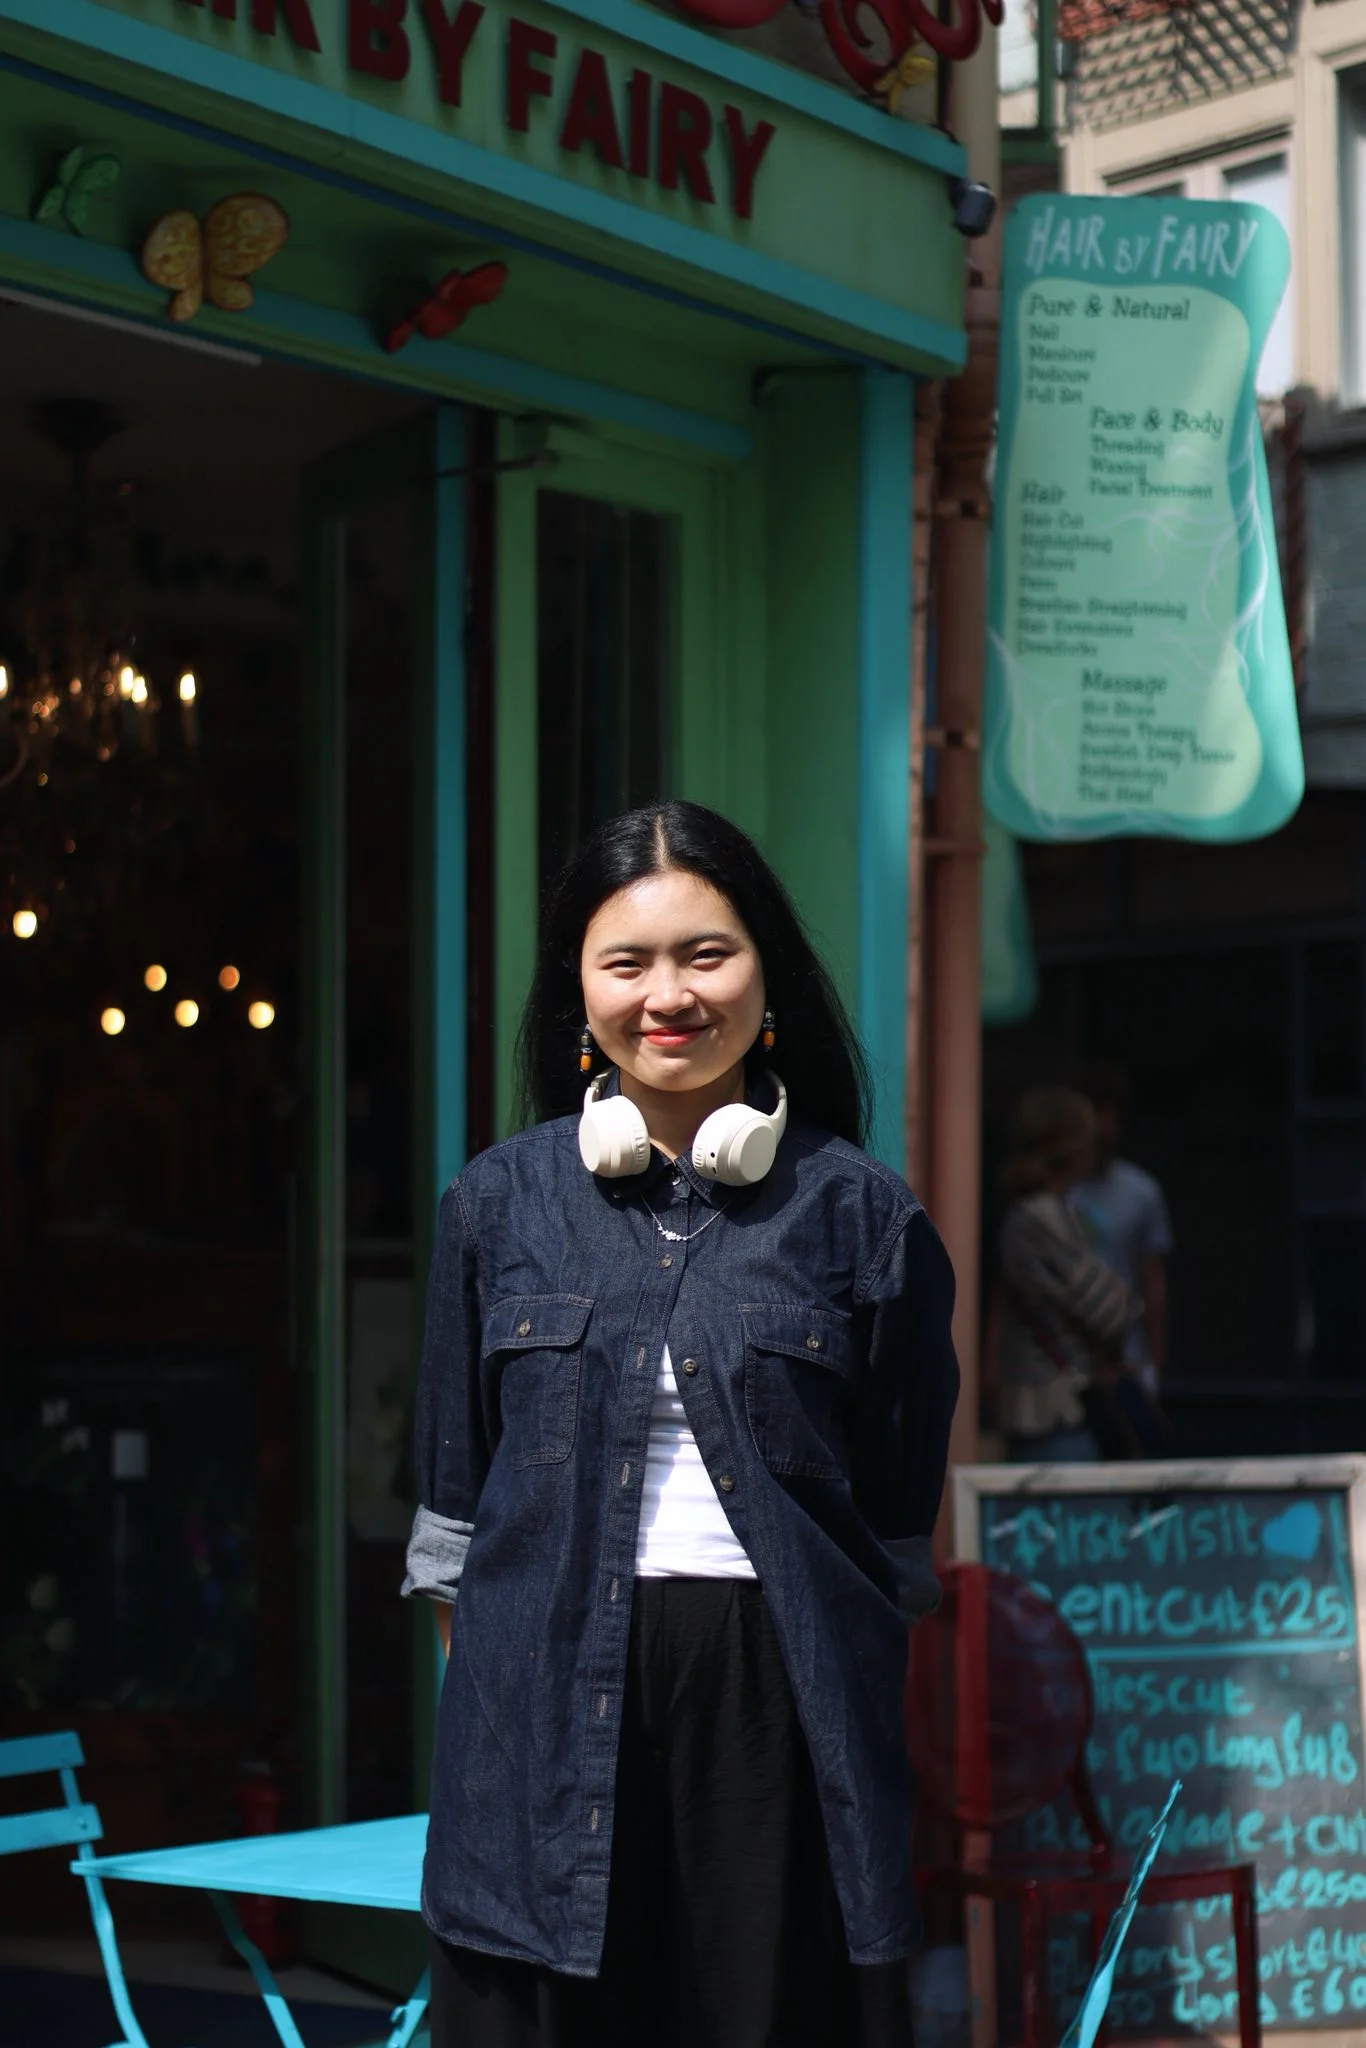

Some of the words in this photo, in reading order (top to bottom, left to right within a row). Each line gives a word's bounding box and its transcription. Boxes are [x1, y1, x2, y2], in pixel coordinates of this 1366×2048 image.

[347, 0, 484, 108] BY
[508, 18, 777, 220] FAIRY
[1024, 205, 1105, 275] HAIR
[1114, 235, 1149, 275] BY
[1151, 213, 1259, 279] FAIRY
[1027, 293, 1076, 317] Pure
[1084, 293, 1104, 319] &
[1111, 295, 1190, 321] Natural
[1028, 322, 1060, 341] Nail
[1027, 345, 1097, 362] Manicure
[1027, 365, 1091, 383] Pedicure
[1090, 407, 1136, 431] Face
[1143, 407, 1163, 432] &
[1171, 408, 1224, 440] Body
[1091, 435, 1166, 459] Threading
[1090, 456, 1148, 477] Waxing
[1021, 480, 1066, 504] Hair
[1081, 667, 1168, 699] Massage
